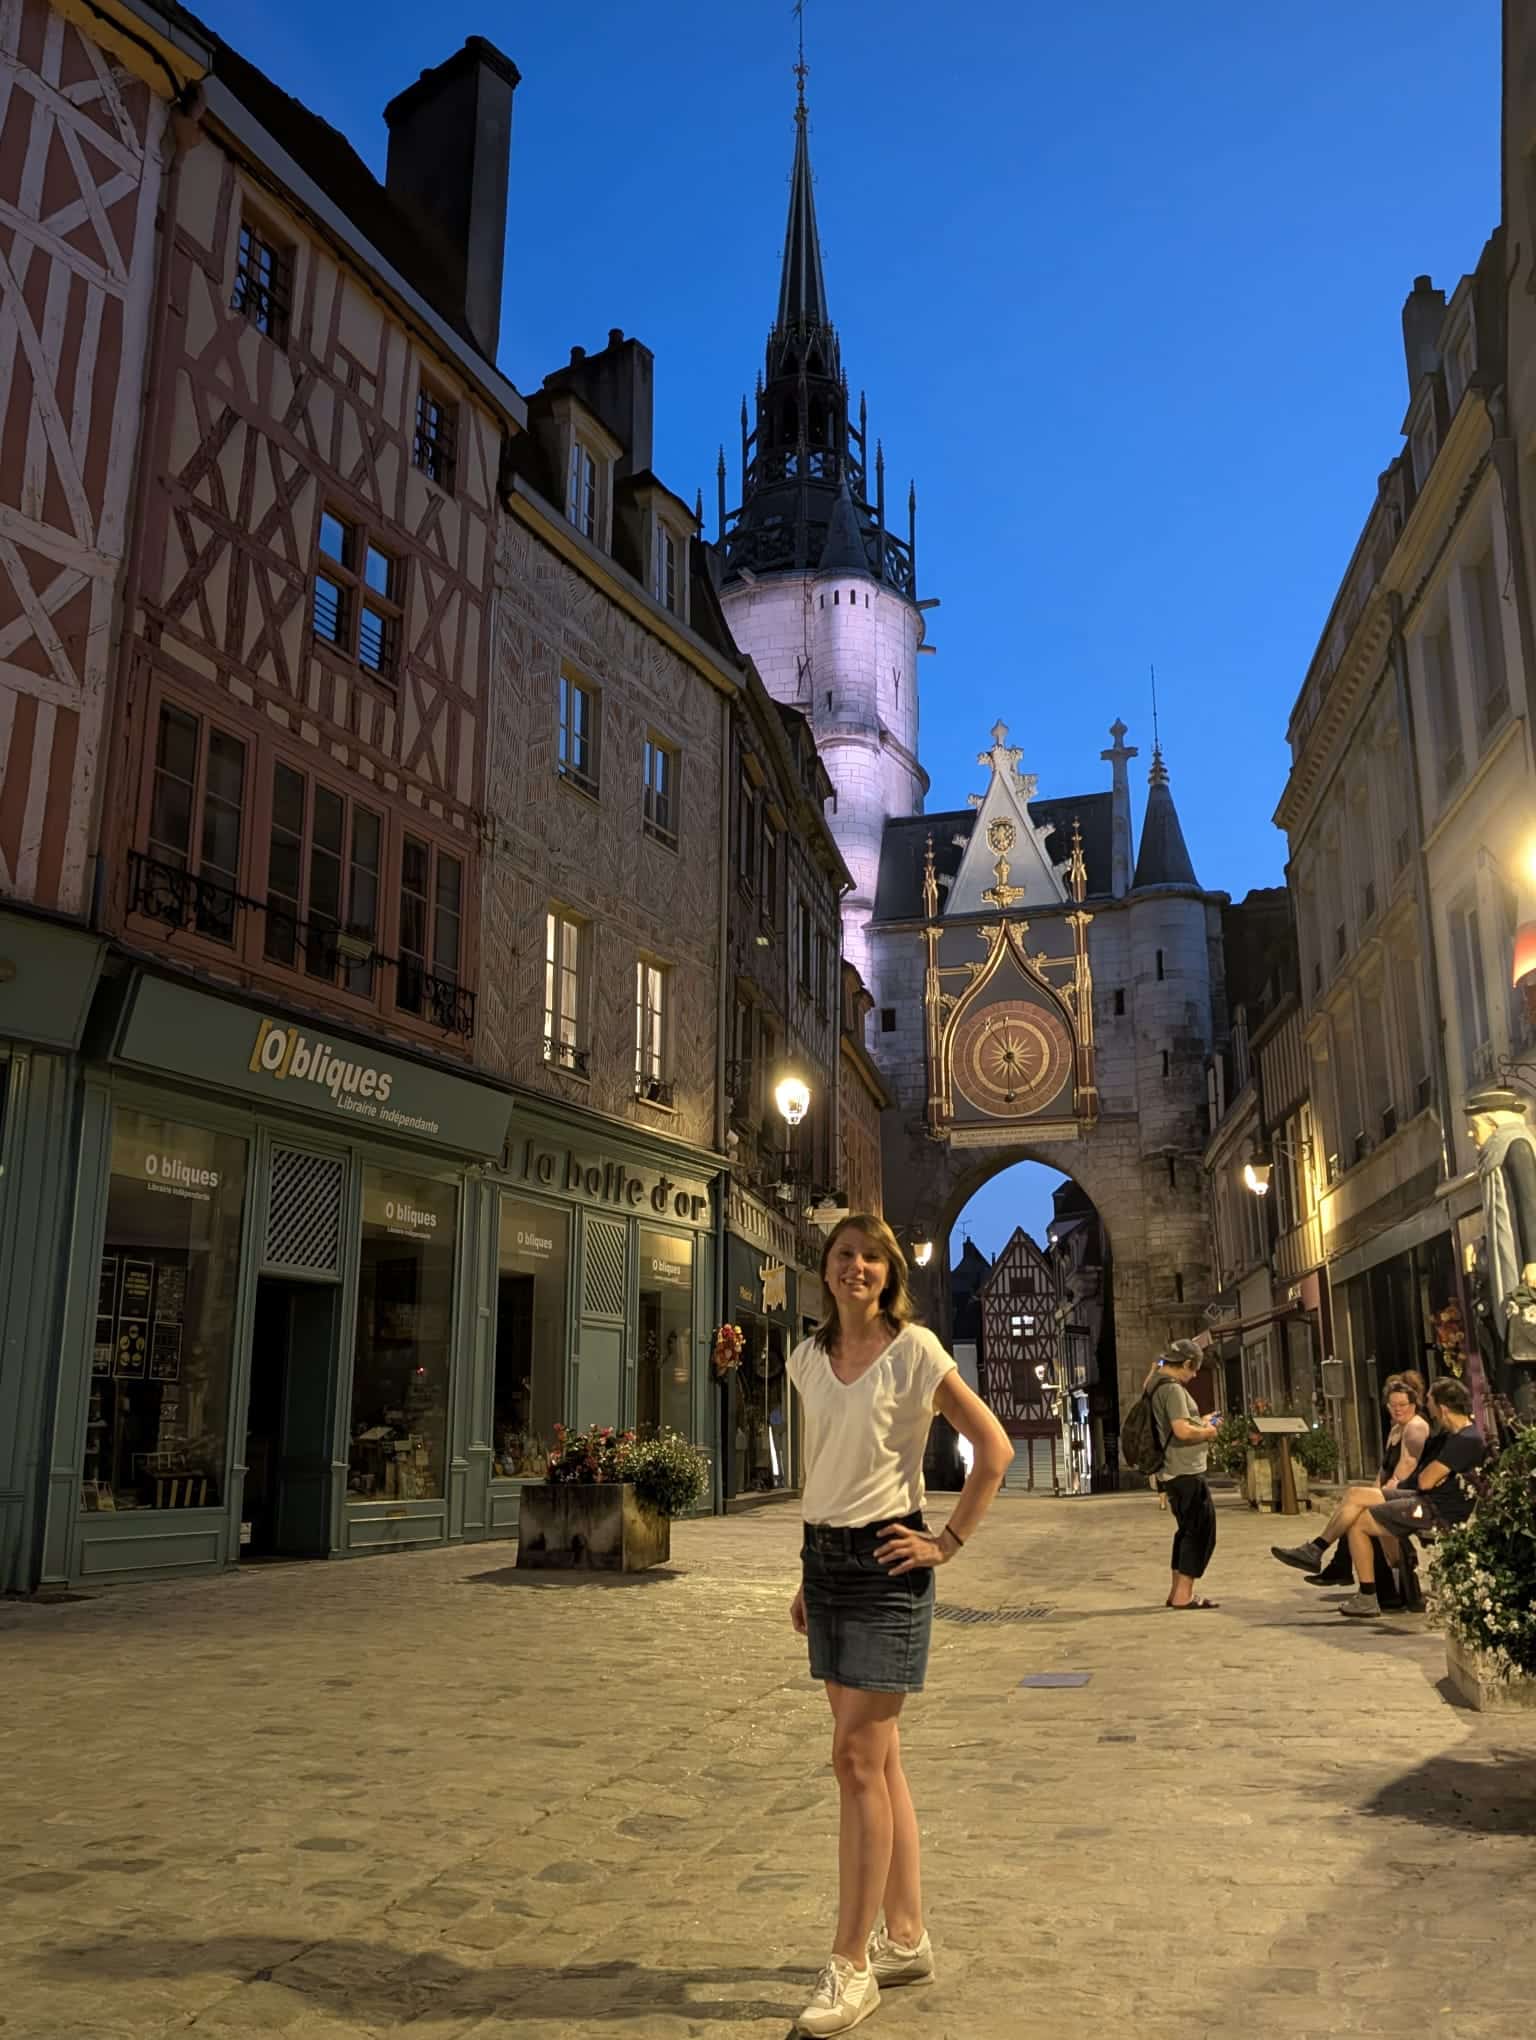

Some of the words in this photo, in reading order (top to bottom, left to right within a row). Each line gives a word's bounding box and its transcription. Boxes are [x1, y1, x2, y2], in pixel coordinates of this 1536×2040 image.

[336, 1094, 377, 1117] Librairie
[379, 1106, 440, 1135] indépendante
[520, 1138, 557, 1184] la
[650, 1175, 707, 1222] d'or
